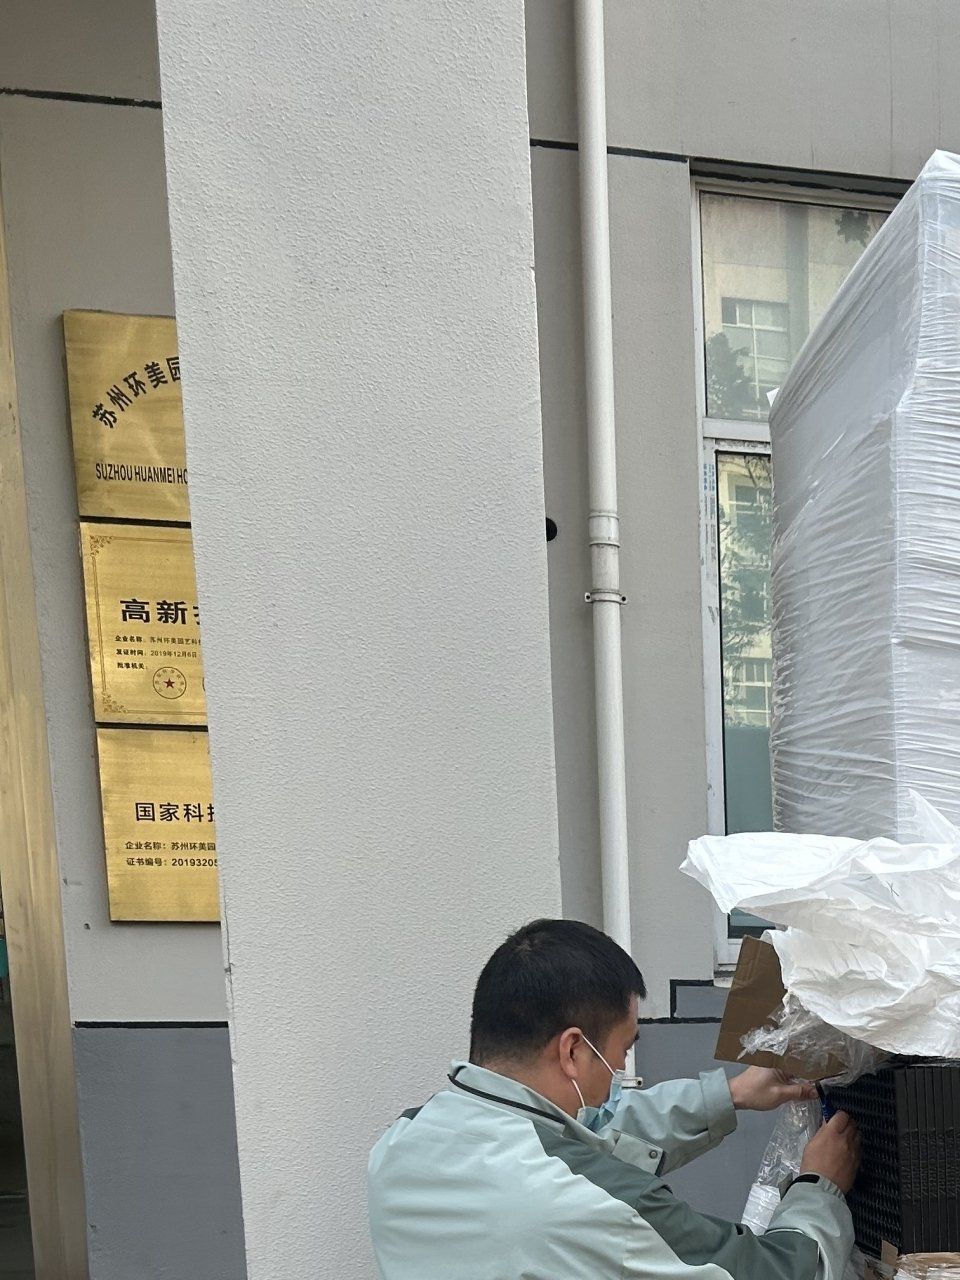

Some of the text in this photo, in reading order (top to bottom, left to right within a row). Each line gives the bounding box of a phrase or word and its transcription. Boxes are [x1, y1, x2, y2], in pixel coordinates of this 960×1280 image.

[95, 463, 133, 481] SUZHOU
[135, 465, 176, 484] HUANMEI
[120, 598, 200, 626] 高新
